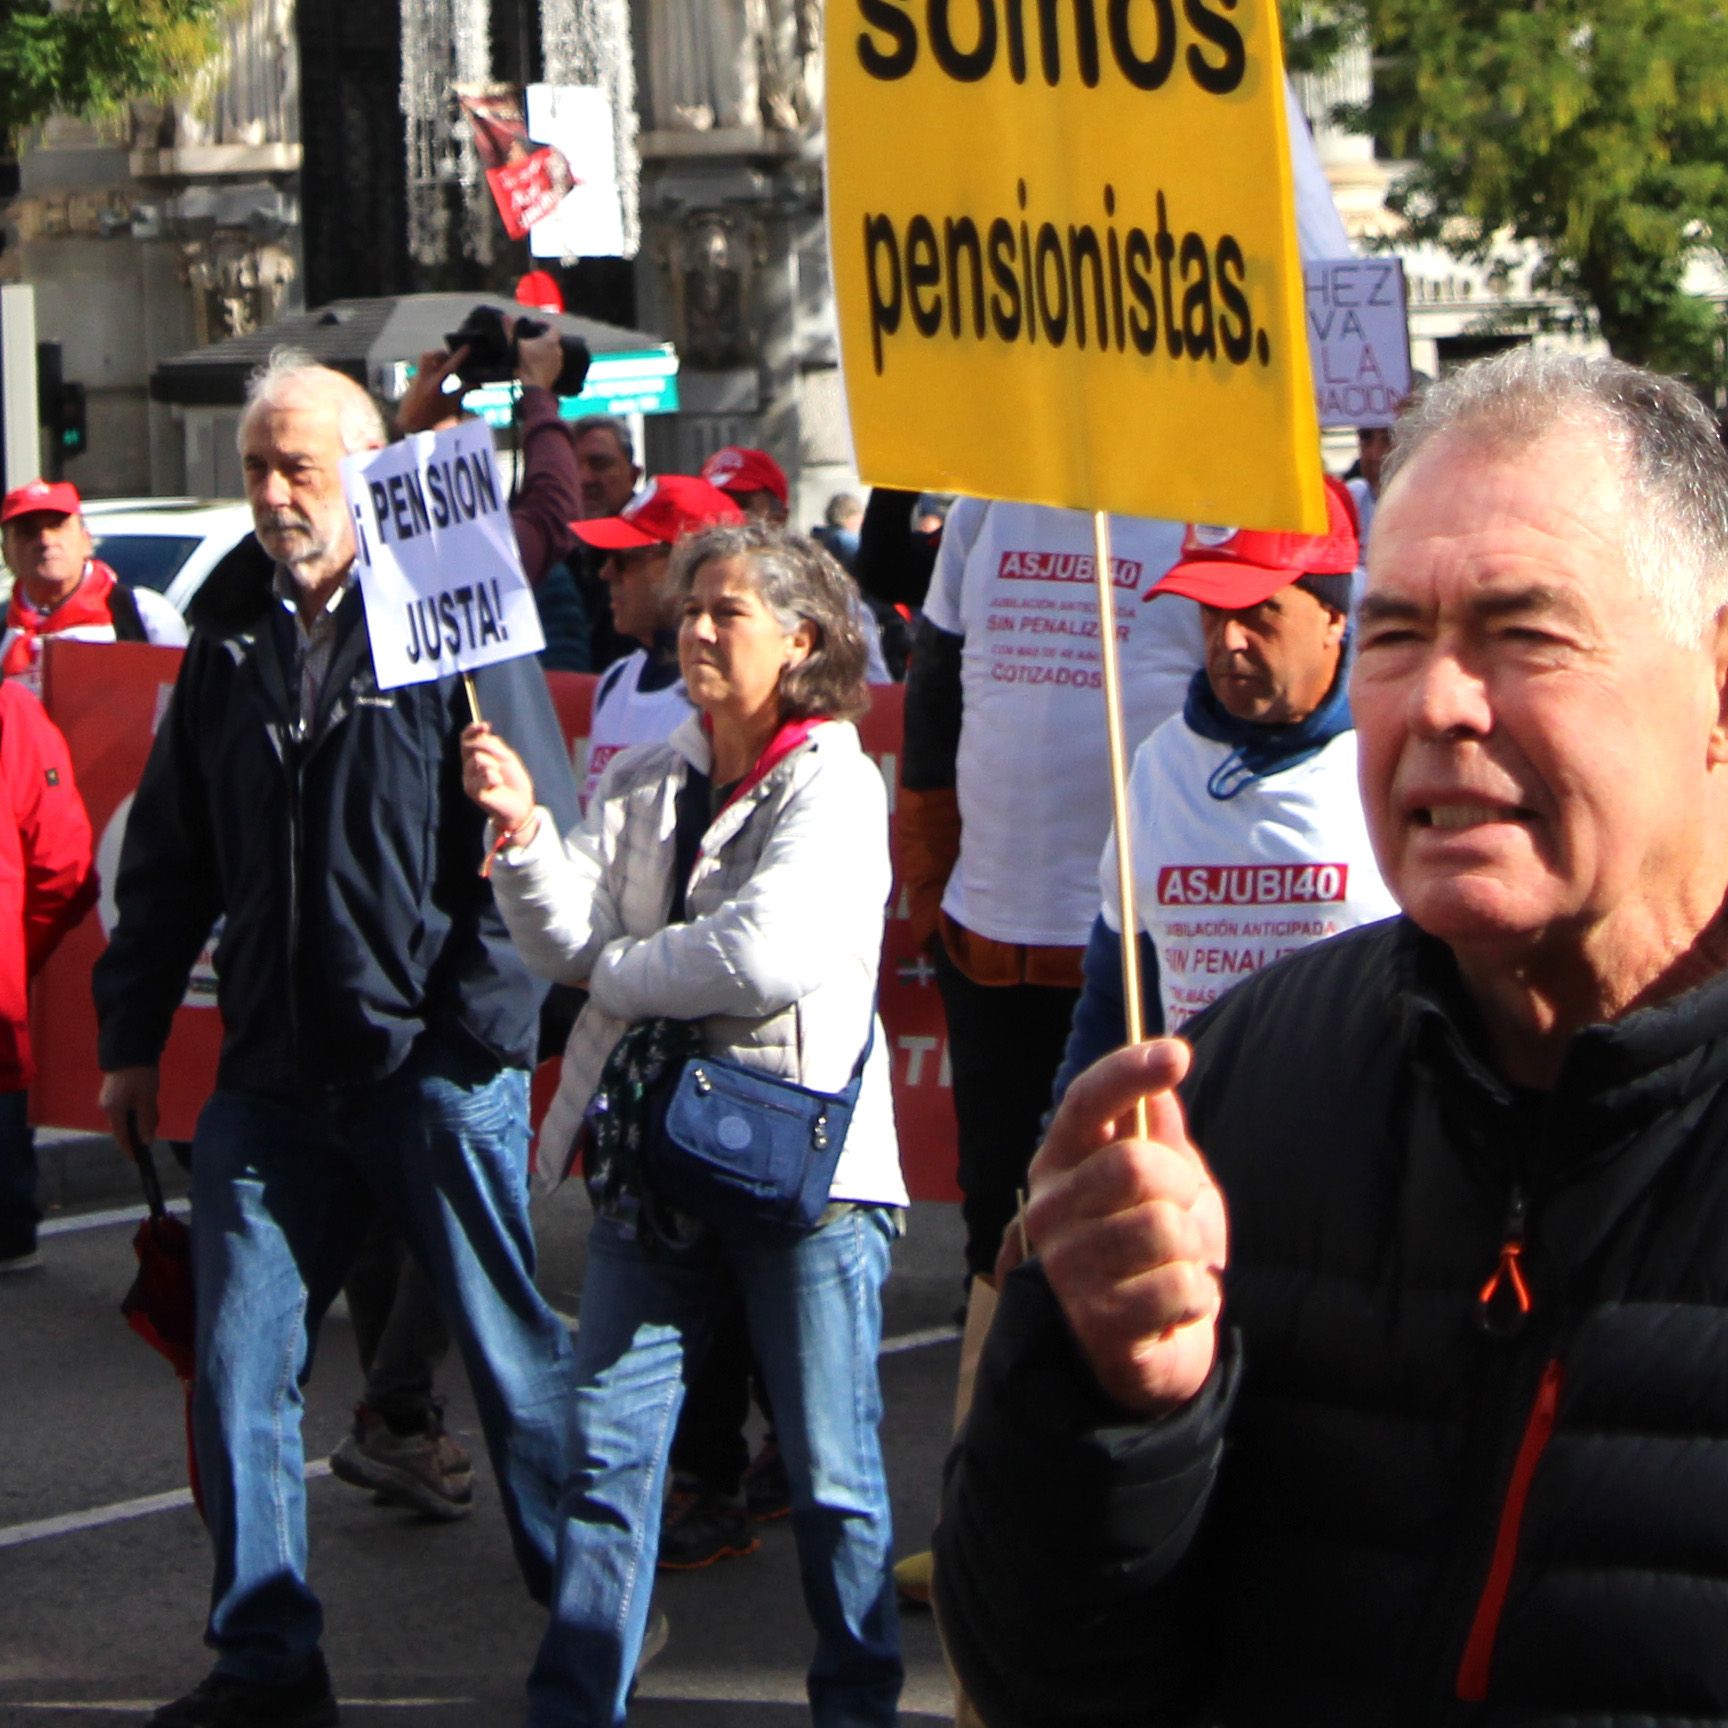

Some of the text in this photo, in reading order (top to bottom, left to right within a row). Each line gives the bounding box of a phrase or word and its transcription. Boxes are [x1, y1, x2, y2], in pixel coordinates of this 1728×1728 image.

[864, 178, 1270, 377] pensionistas.
[1323, 344, 1384, 385] LA
[406, 576, 509, 664] JUSTA!
[986, 615, 1130, 643] SIN PENALIZR
[990, 661, 1103, 690] COTIZADOS
[1162, 865, 1342, 905] ASJUBI40
[1165, 918, 1337, 938] BILACIÓN ANTICIPADA
